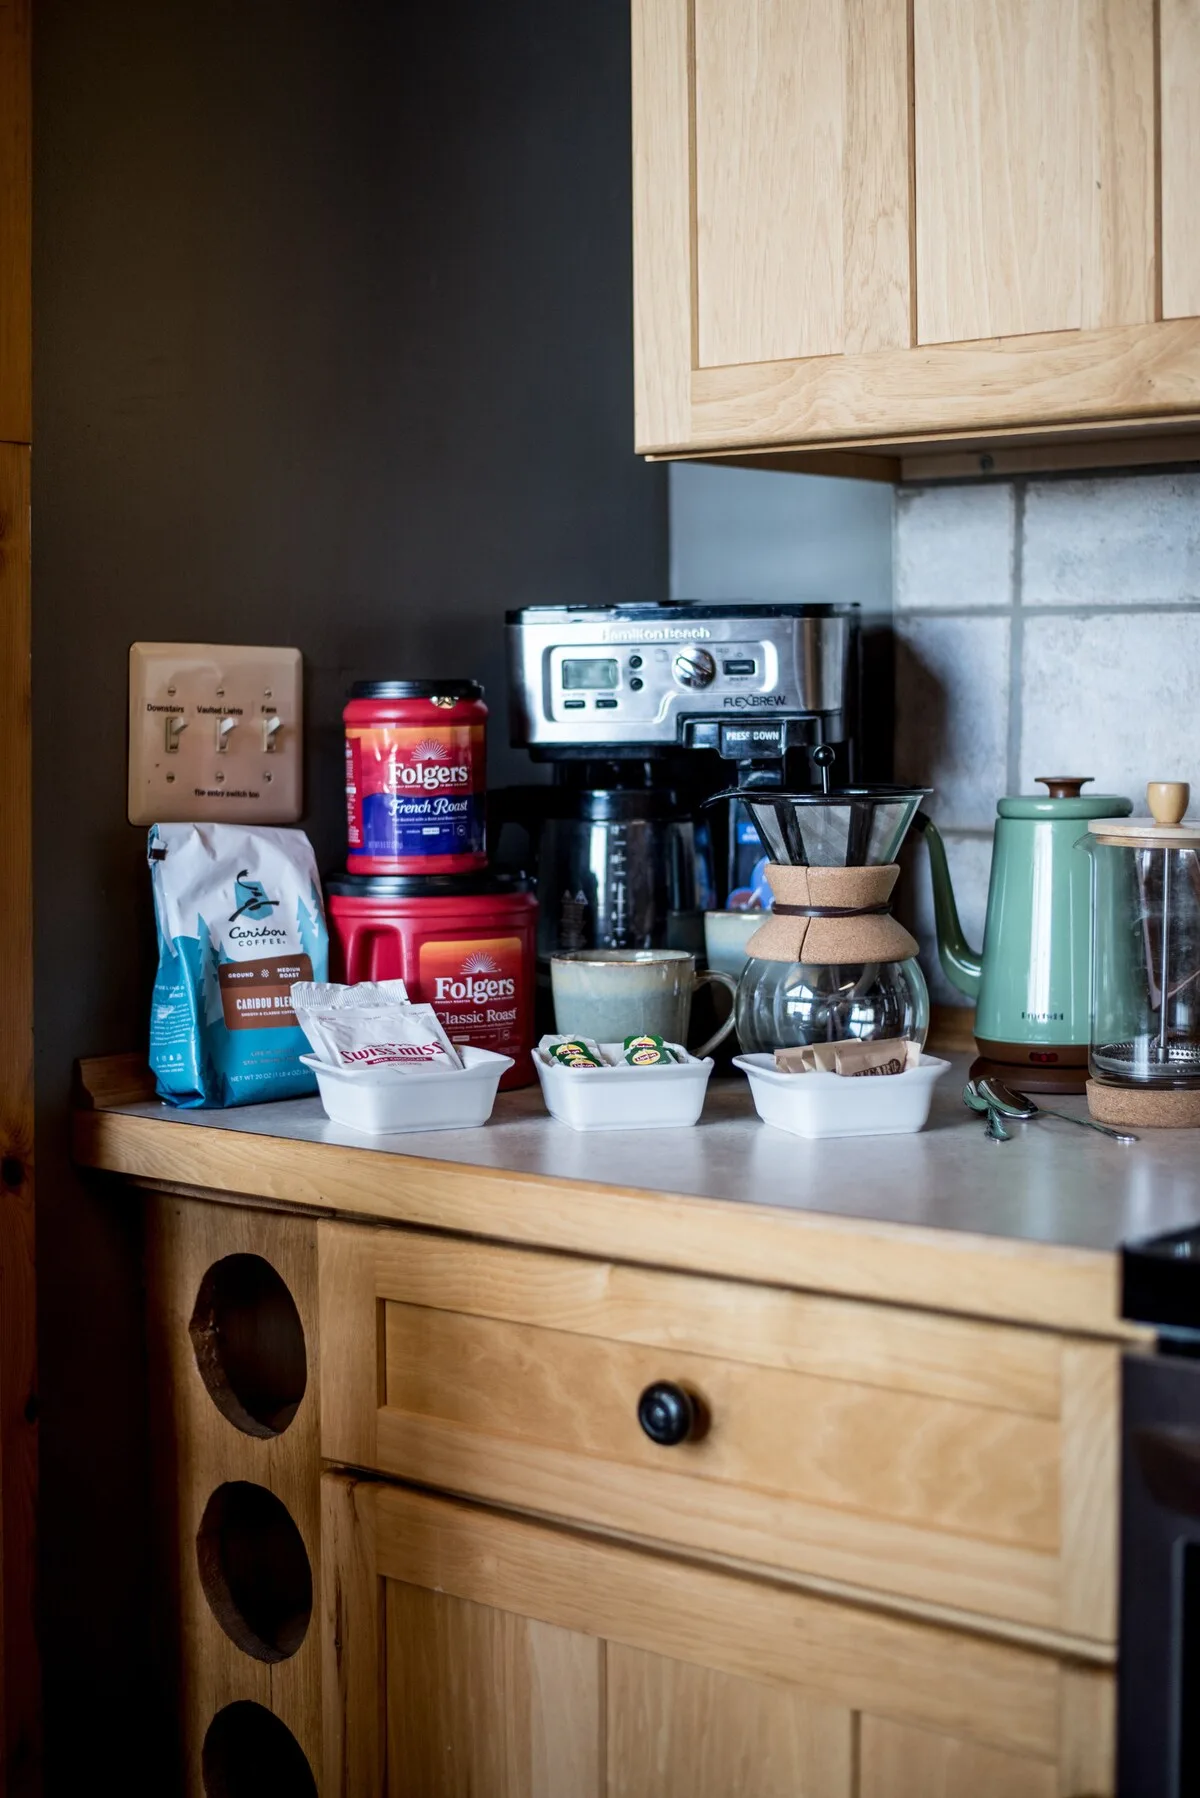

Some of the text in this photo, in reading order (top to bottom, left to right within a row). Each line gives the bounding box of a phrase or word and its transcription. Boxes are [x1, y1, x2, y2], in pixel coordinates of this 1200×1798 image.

[147, 704, 184, 713] Downstairs
[388, 762, 468, 790] Folgers
[388, 798, 468, 816] French Roast
[229, 926, 287, 939] Caribou
[238, 938, 283, 946] COFFEE
[434, 976, 515, 1005] Folgers
[236, 997, 272, 1010] CARIBOU
[435, 1007, 517, 1025] Classic Roast
